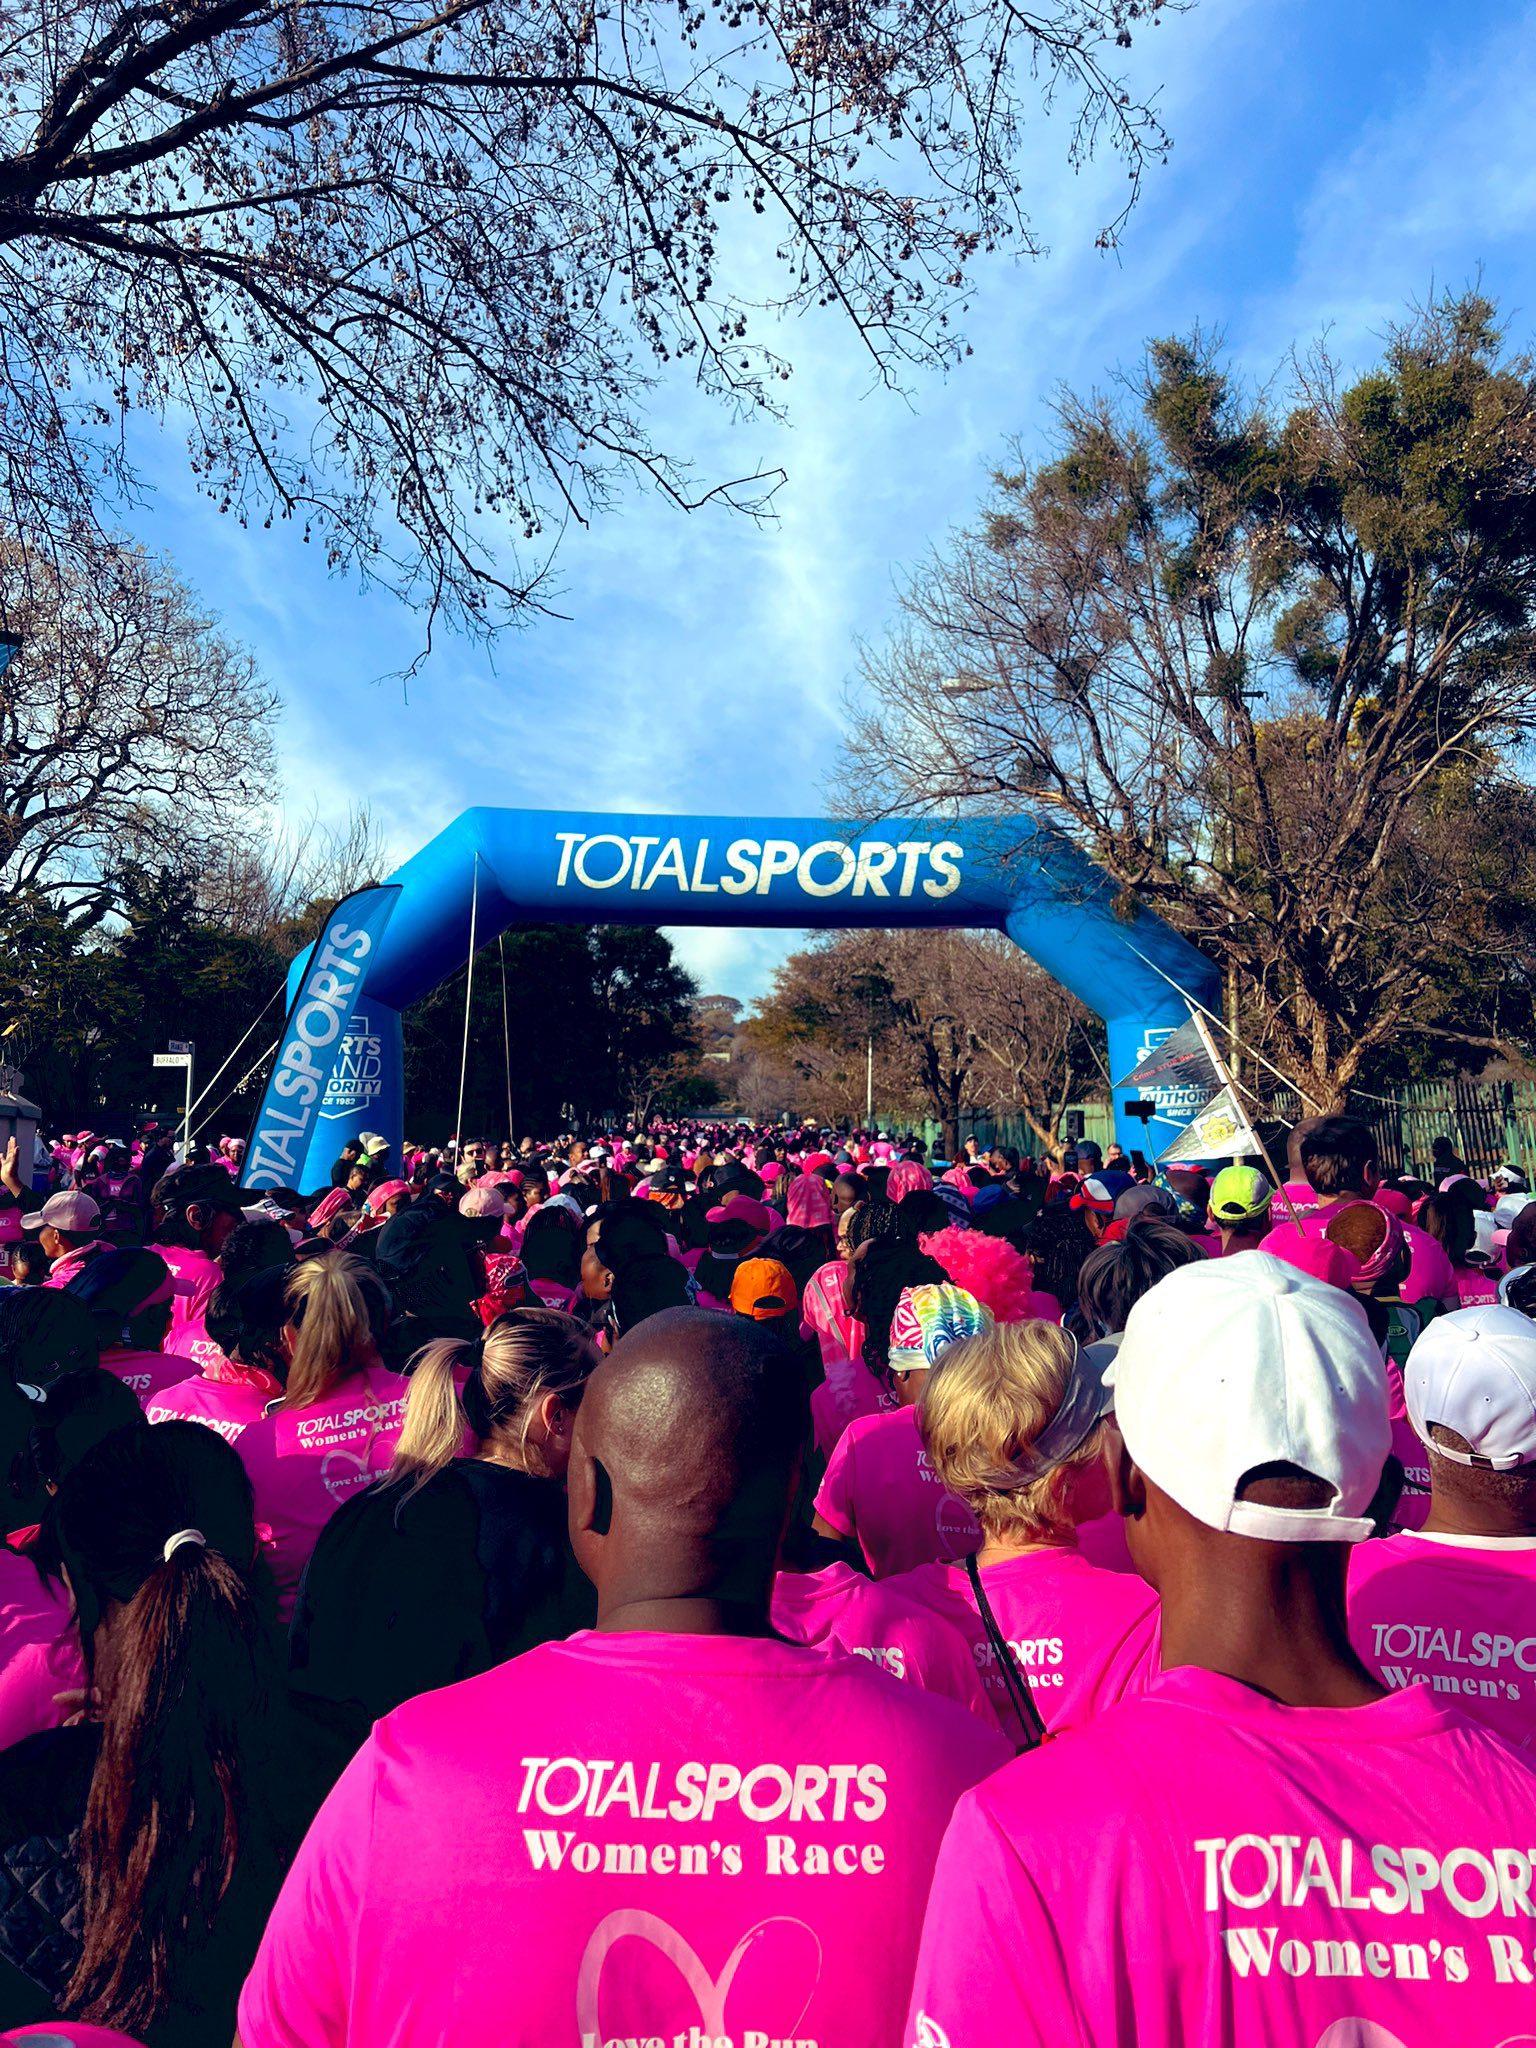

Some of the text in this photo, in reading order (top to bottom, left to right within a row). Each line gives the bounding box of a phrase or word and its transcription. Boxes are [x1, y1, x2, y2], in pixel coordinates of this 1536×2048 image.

[556, 833, 963, 898] TOTALSPORTS
[336, 1097, 355, 1105] 1982
[1166, 1107, 1193, 1117] SINCE
[296, 1399, 408, 1437] TOTALSPORTS
[299, 1427, 367, 1449] Women's
[1371, 1623, 1536, 1672] TOTALSPO
[1379, 1665, 1520, 1701] Women's
[517, 1757, 888, 1823] TOTALSPORTS
[522, 1830, 885, 1876] Women's Race
[1194, 1834, 1536, 1918] TOTALSPOR
[1220, 1926, 1469, 1984] Women's
